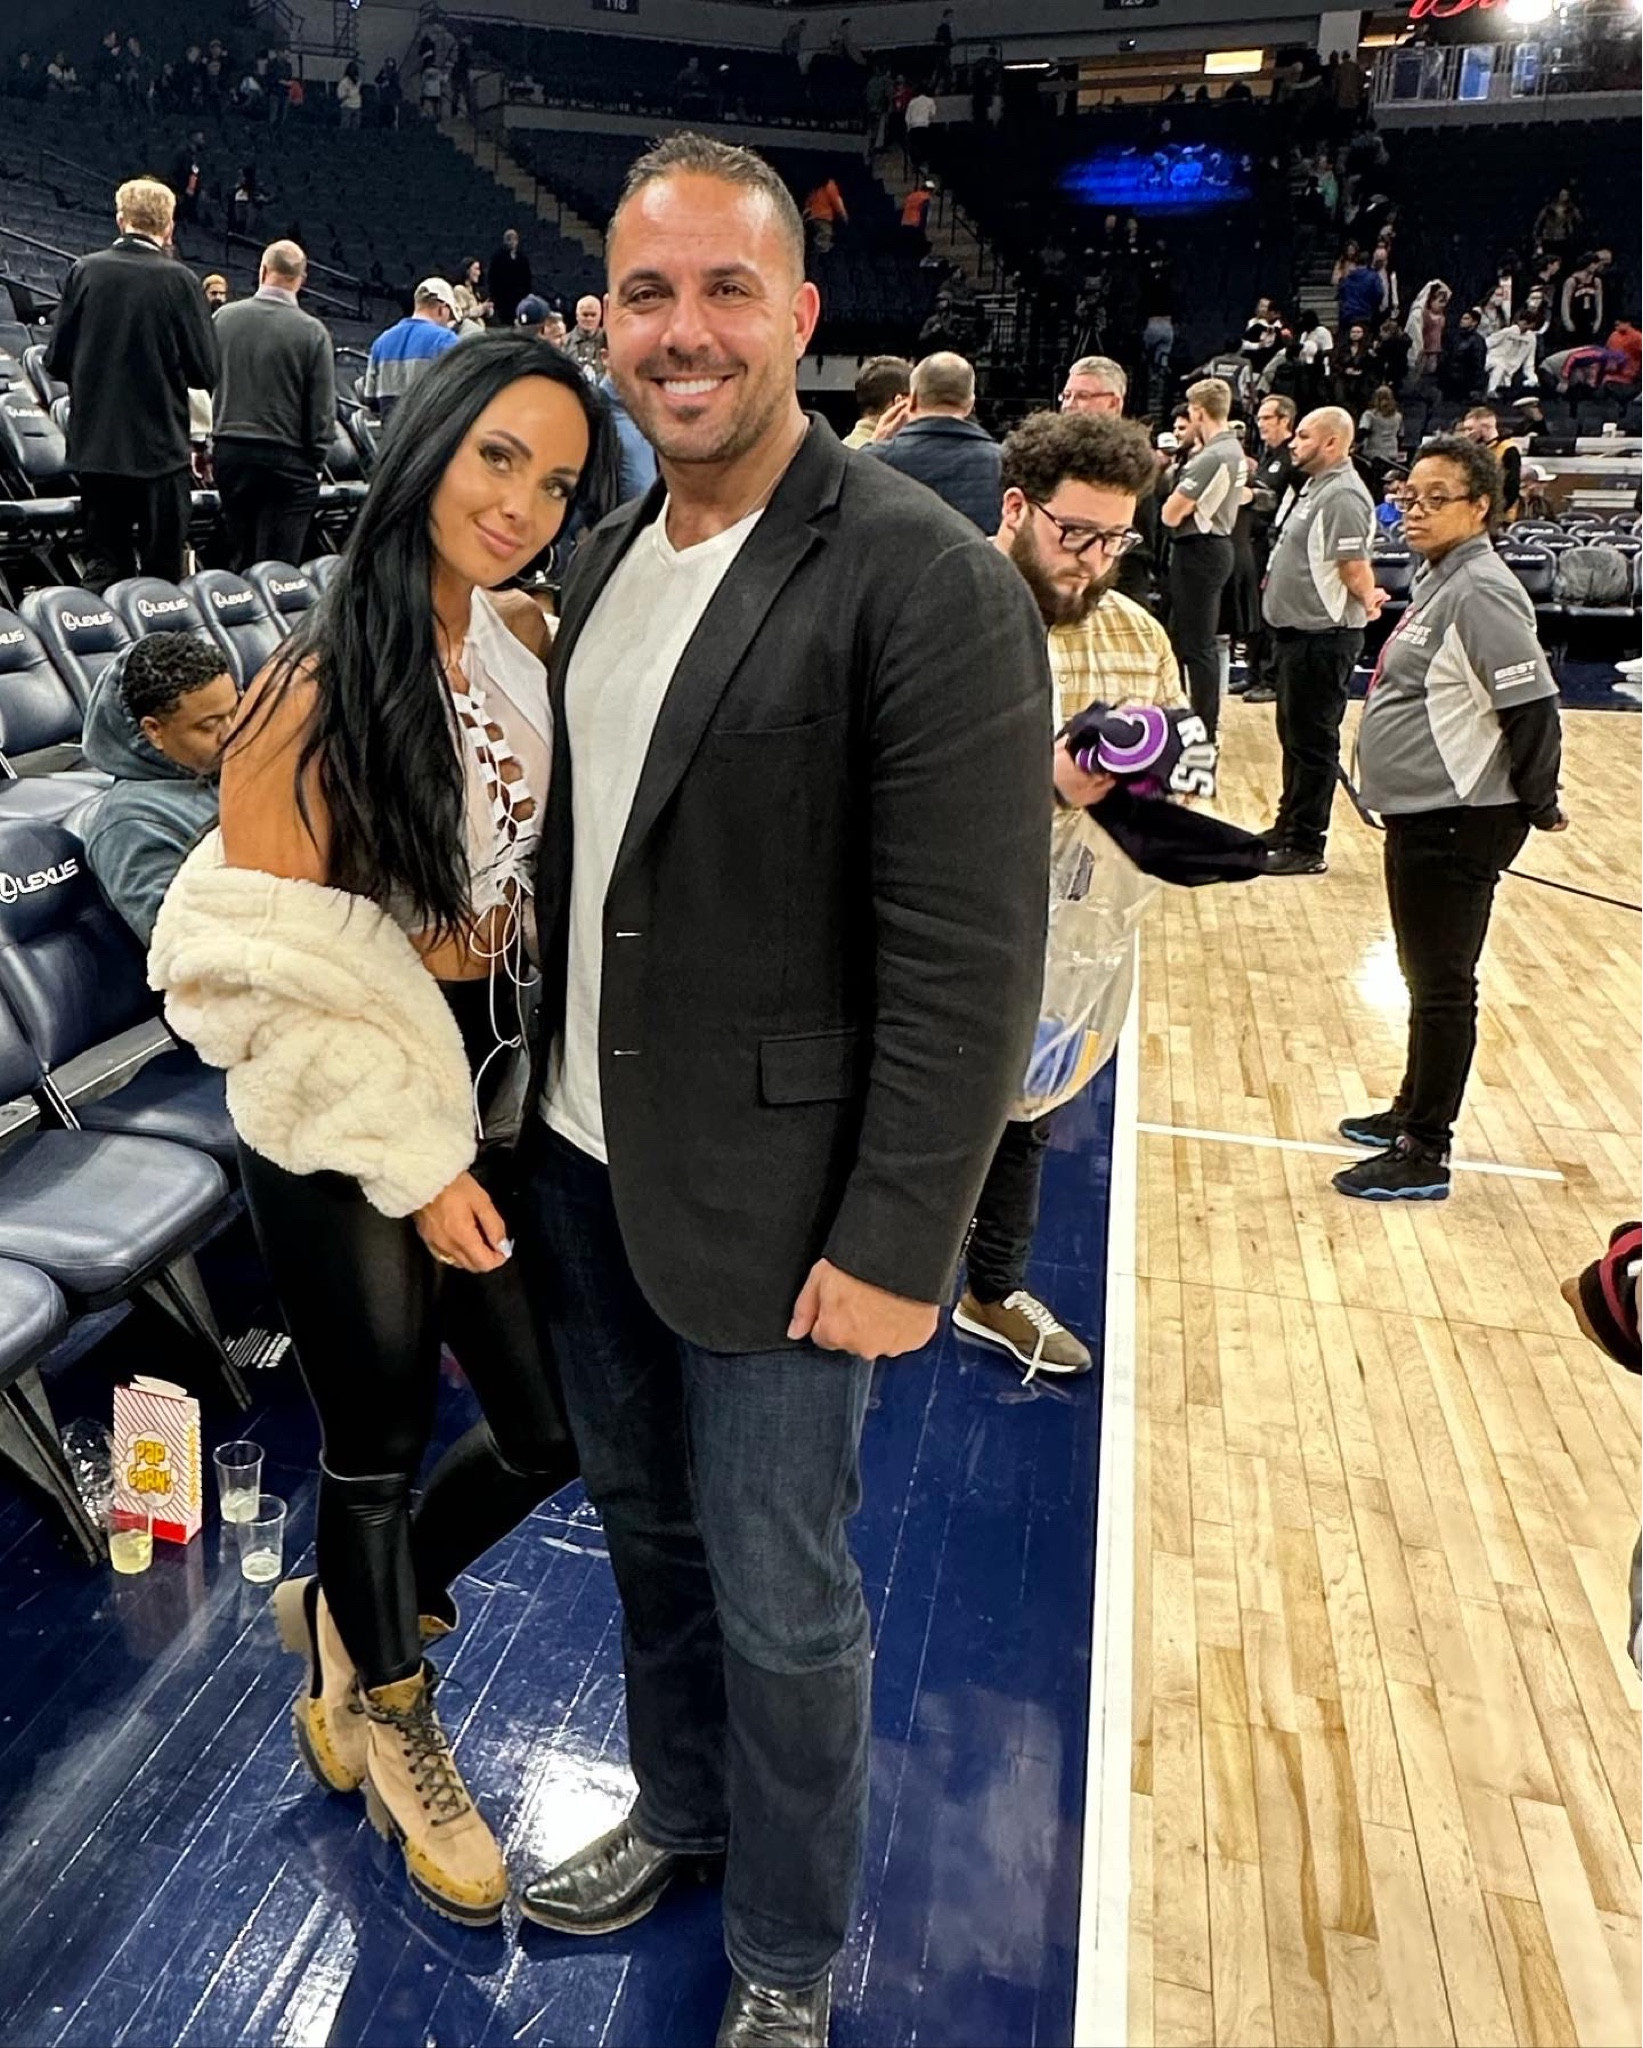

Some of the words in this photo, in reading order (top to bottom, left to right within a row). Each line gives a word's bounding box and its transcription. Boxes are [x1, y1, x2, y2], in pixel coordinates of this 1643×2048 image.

[149, 598, 189, 613] LEXUS
[77, 611, 114, 627] LEXUS
[16, 857, 80, 894] LEXUS
